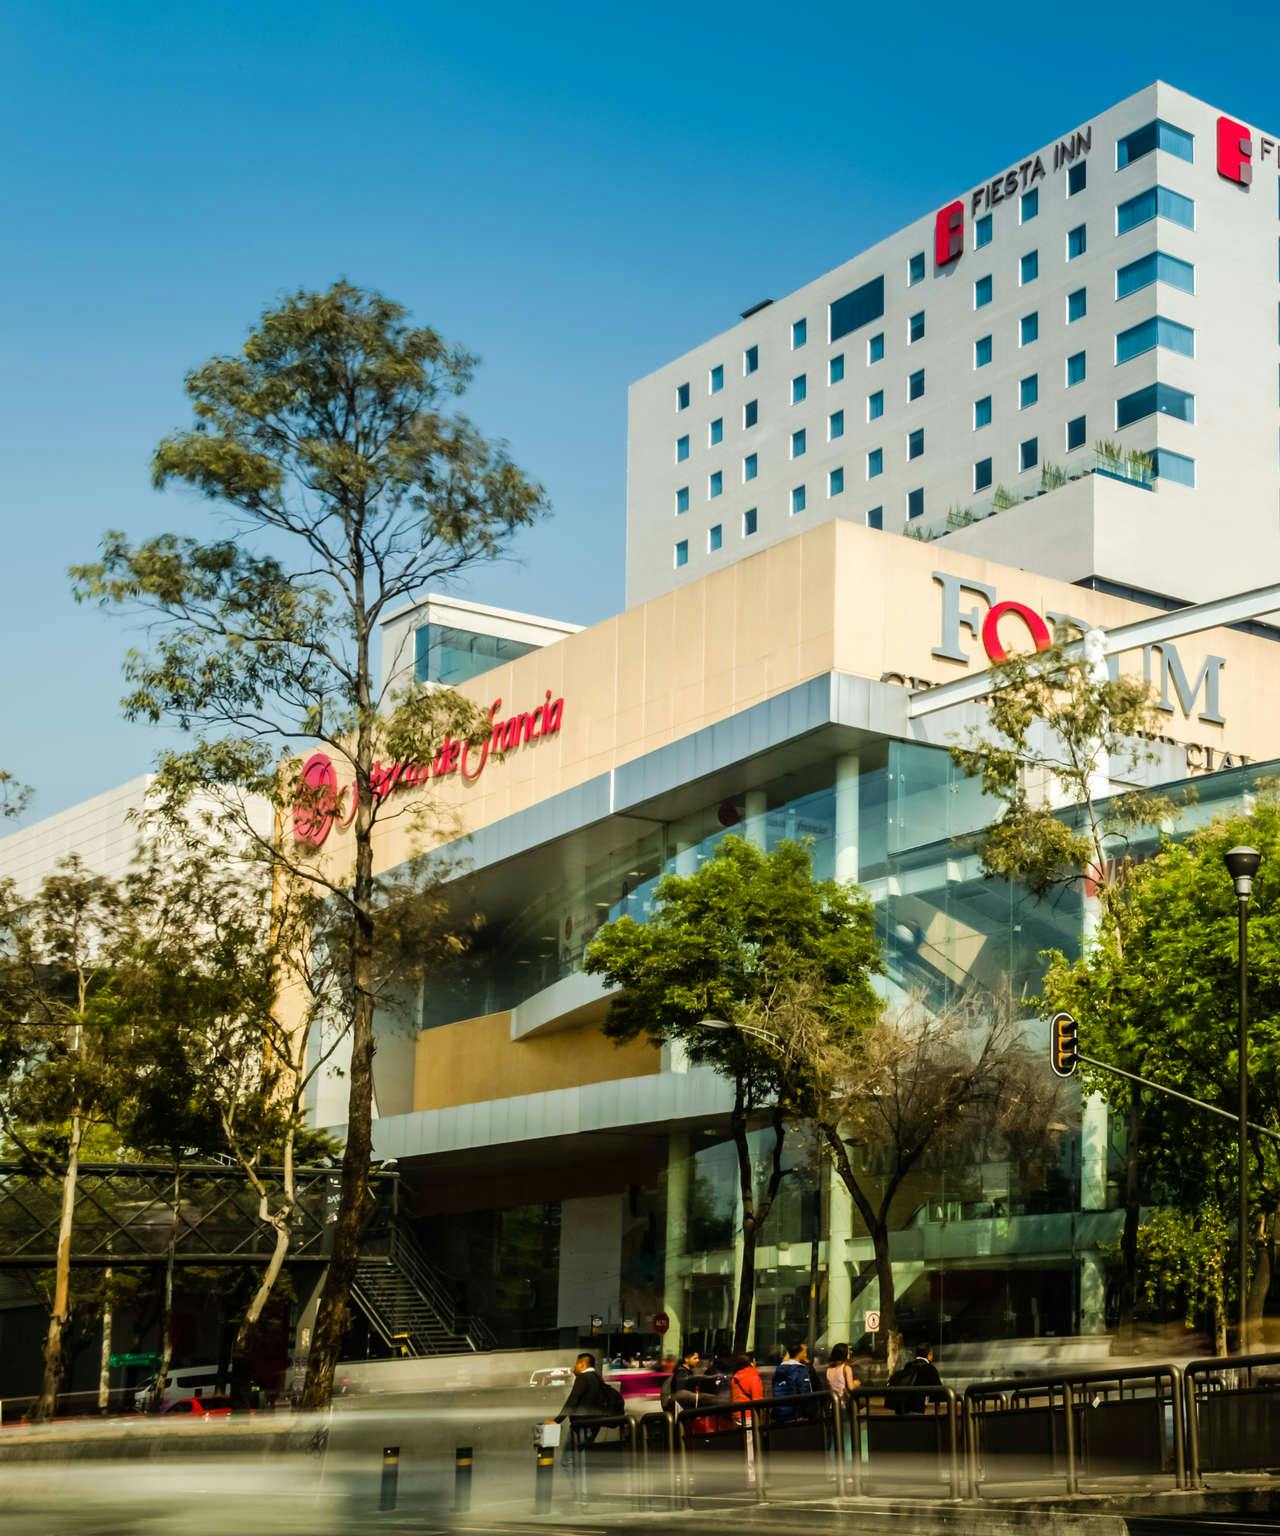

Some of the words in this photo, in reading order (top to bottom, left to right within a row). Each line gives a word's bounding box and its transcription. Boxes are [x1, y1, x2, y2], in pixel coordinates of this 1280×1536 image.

[971, 156, 1046, 219] FIESTA
[1054, 125, 1092, 173] INN
[930, 570, 1227, 727] FOM
